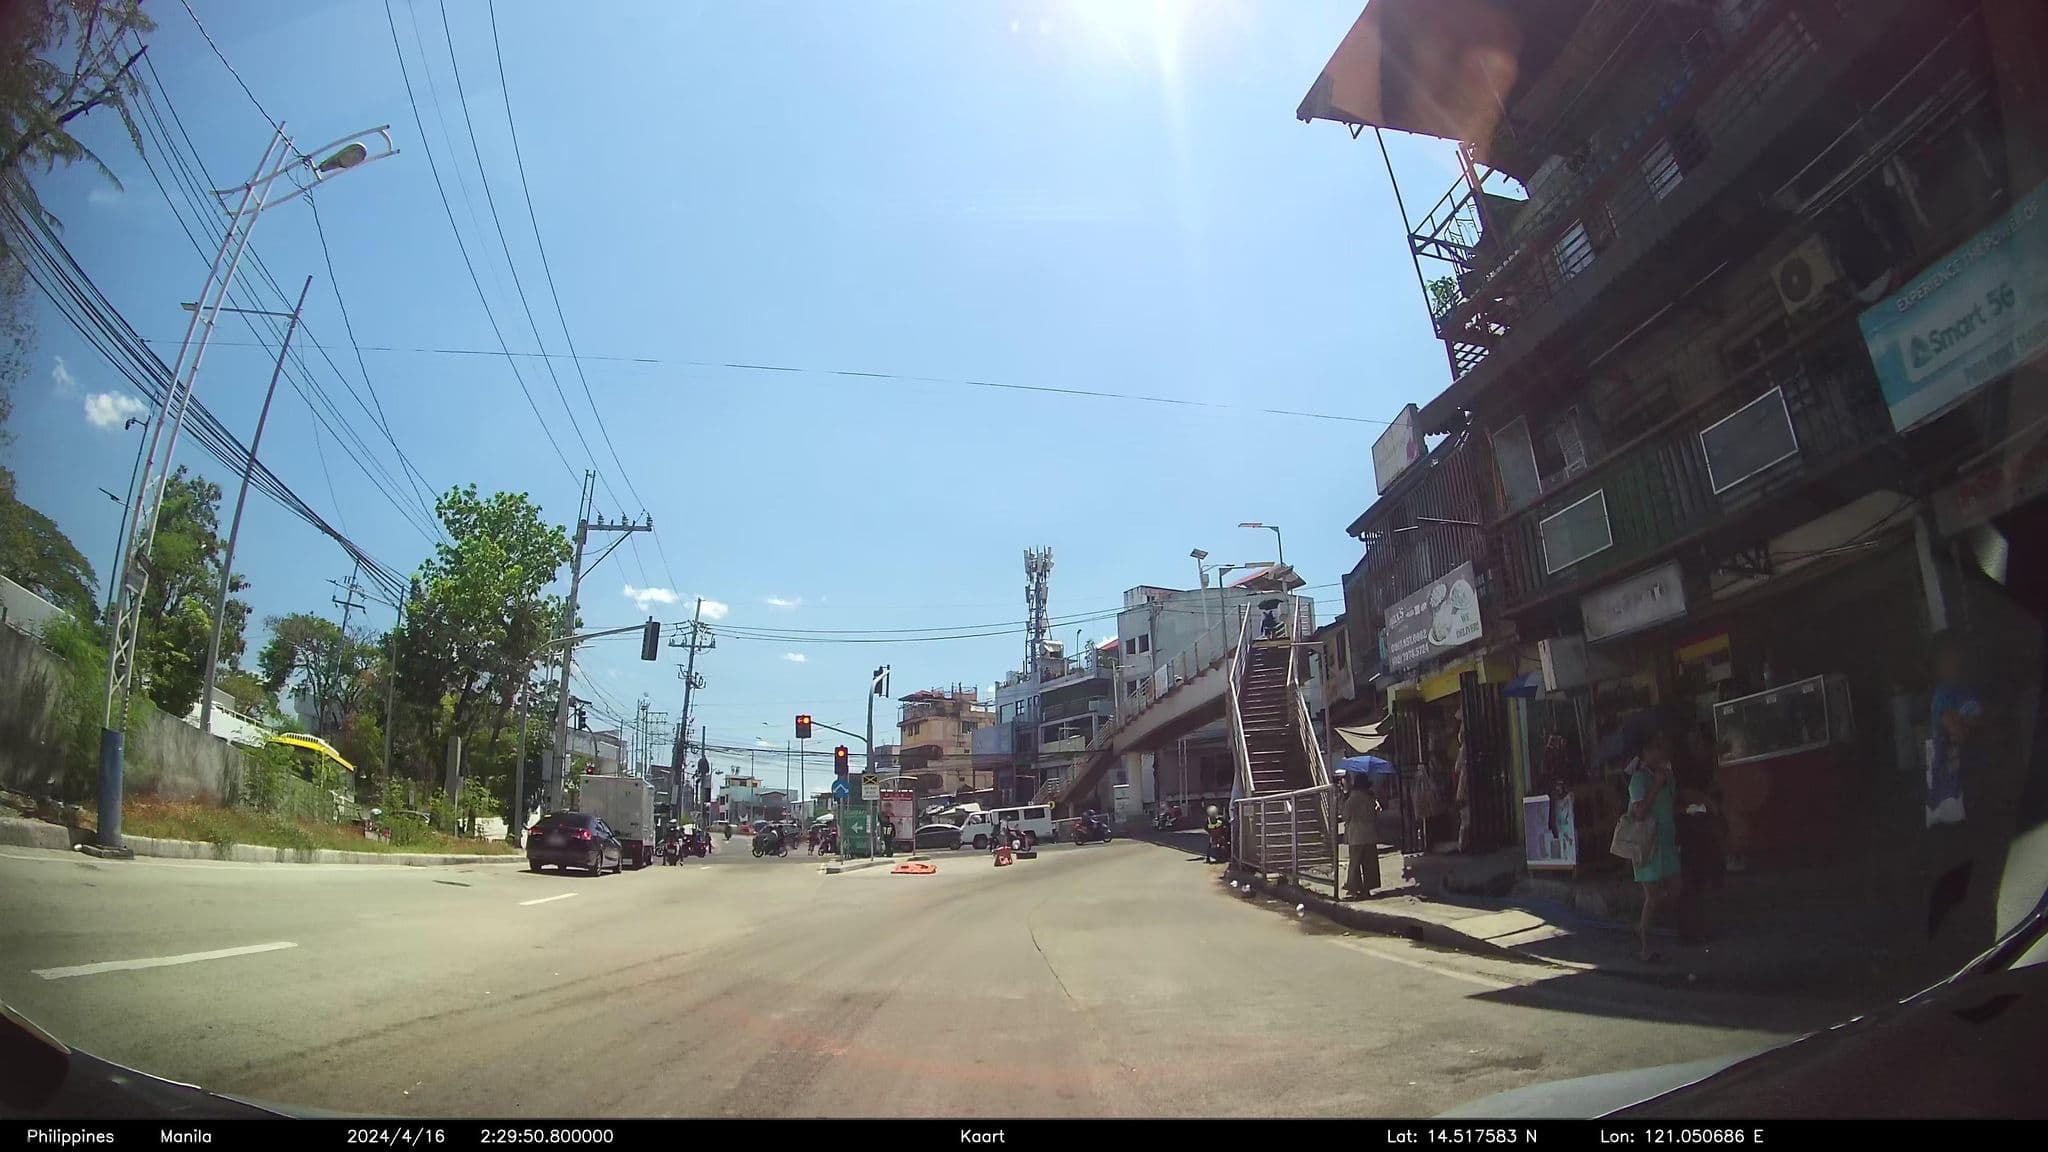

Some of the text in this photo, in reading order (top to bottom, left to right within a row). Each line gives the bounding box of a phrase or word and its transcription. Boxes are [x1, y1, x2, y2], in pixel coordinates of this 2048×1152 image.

[1896, 255, 1961, 312] EXPERIENCE
[1984, 215, 2022, 251] POER
[1929, 301, 1987, 353] Smart
[1986, 281, 2016, 317] 5G
